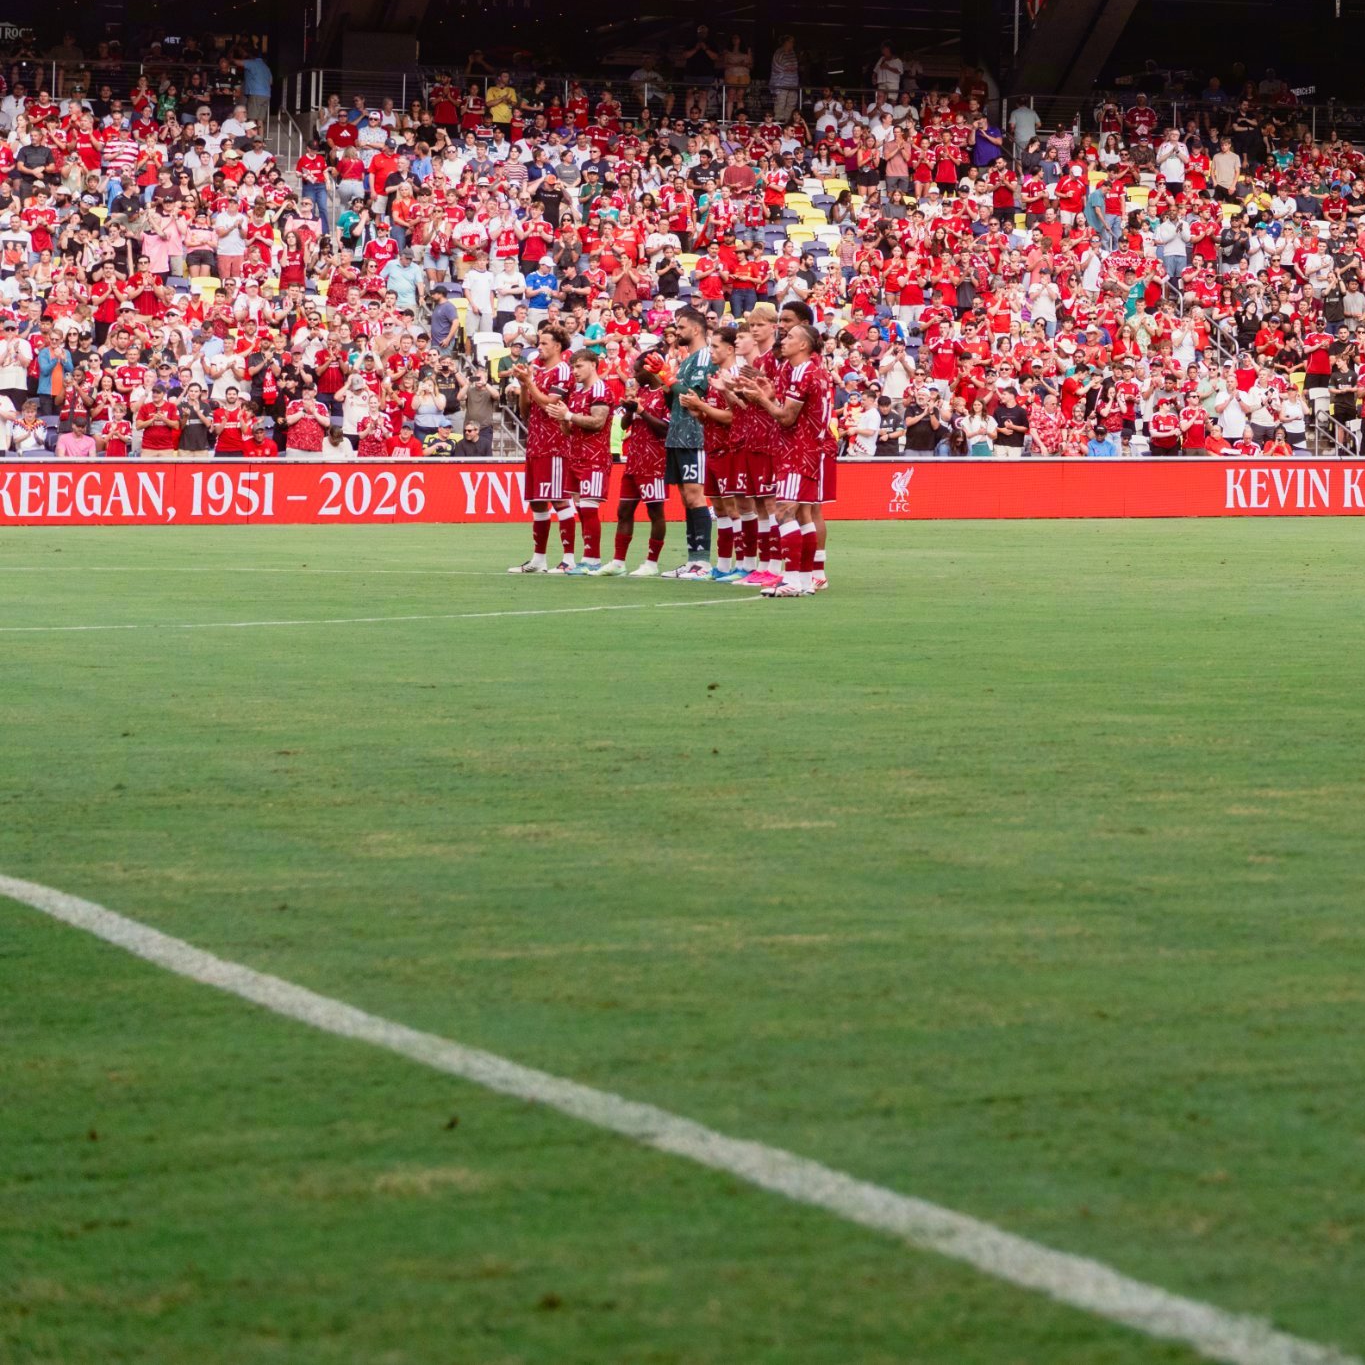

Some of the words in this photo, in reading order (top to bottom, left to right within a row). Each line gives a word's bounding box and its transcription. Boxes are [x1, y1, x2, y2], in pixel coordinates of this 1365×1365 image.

[682, 463, 698, 481] 25
[190, 472, 274, 517] 1951
[318, 471, 425, 517] 2026
[539, 482, 550, 498] 17
[580, 479, 591, 496] 19
[639, 483, 654, 499] 30
[1224, 468, 1331, 509] KEVIN
